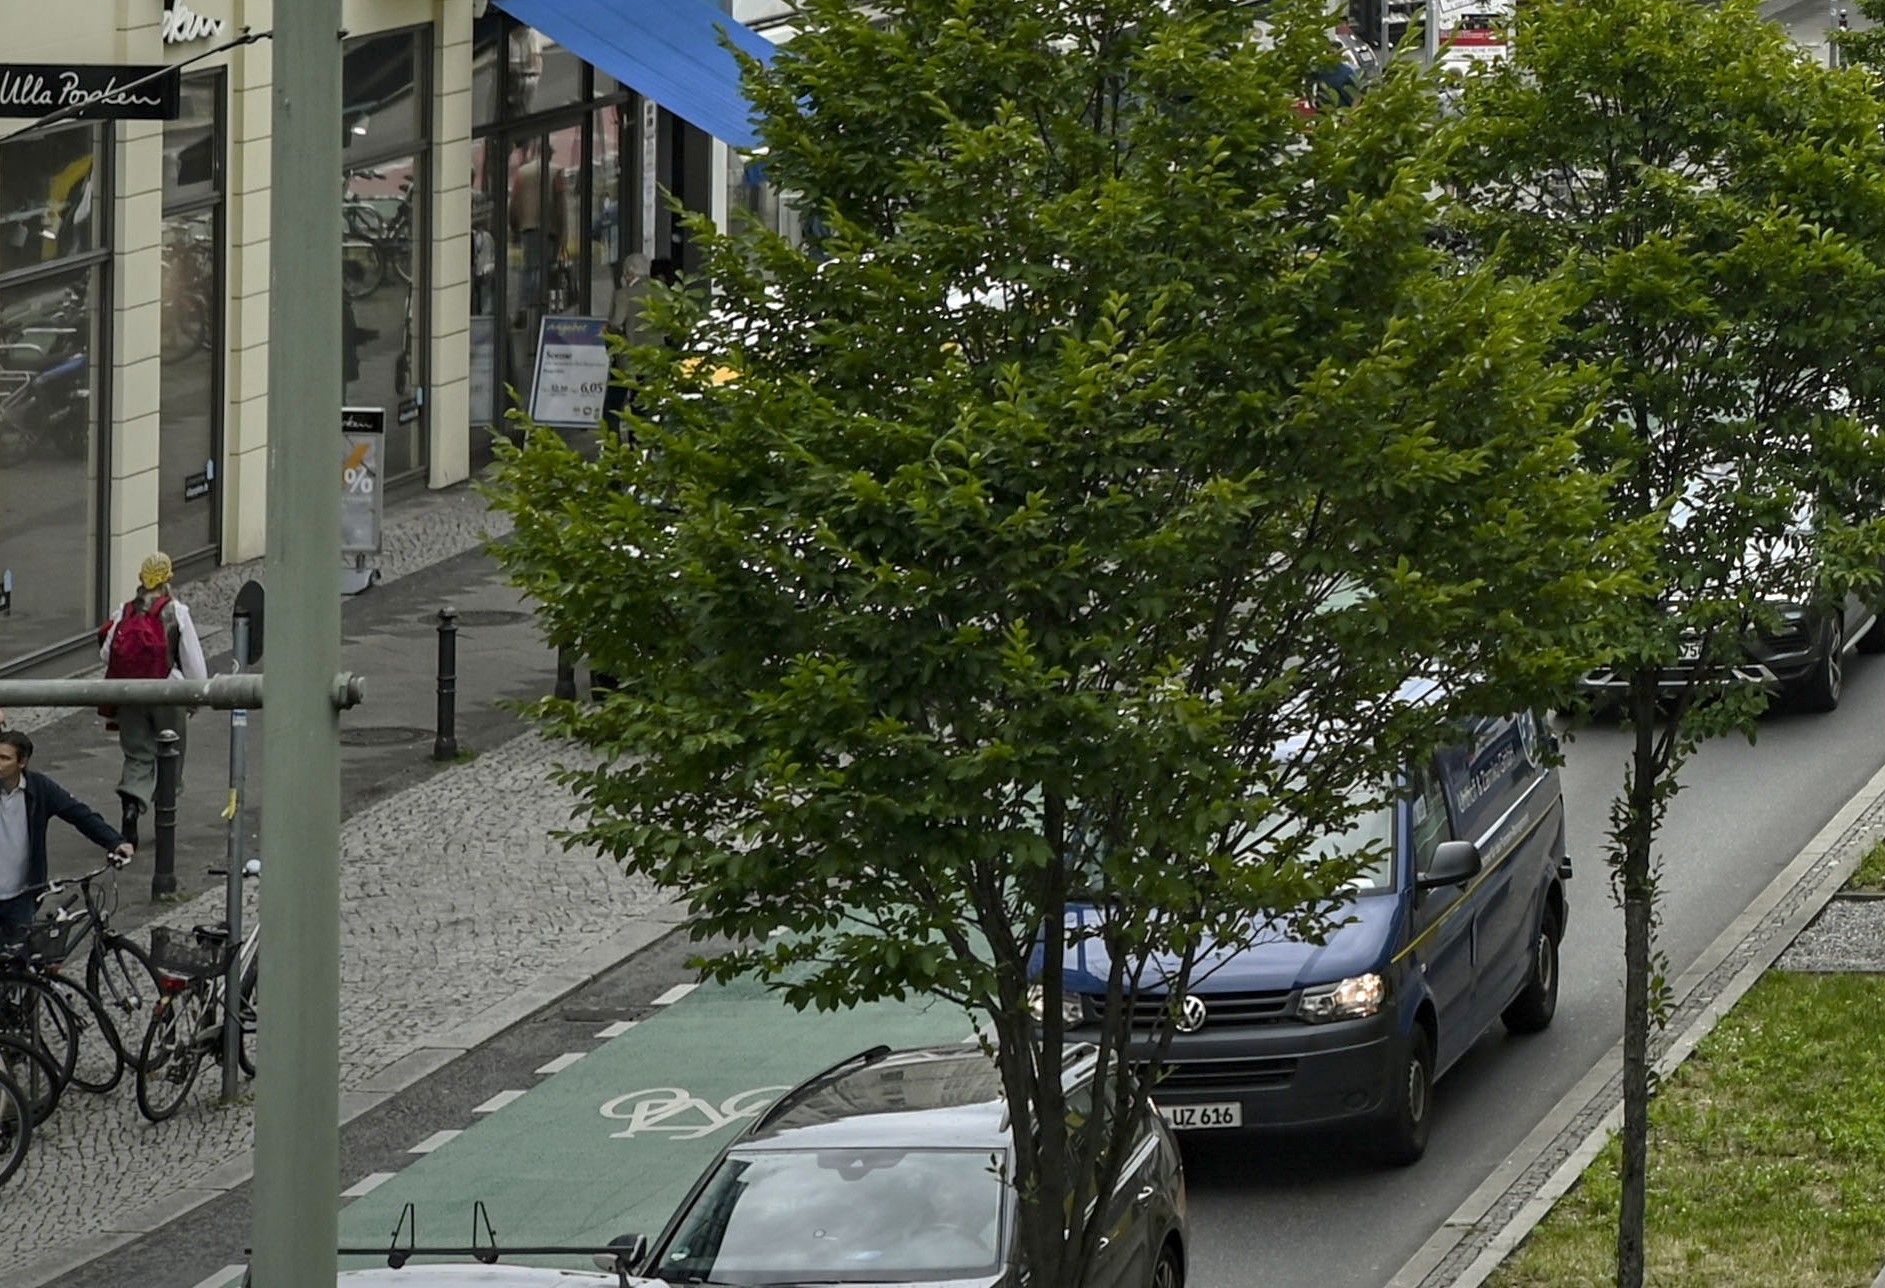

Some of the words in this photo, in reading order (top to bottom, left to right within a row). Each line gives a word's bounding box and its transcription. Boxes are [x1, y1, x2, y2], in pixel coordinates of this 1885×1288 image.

[1, 70, 53, 105] Ulla
[1172, 1108, 1197, 1126] UZ
[1200, 1107, 1234, 1125] 616
